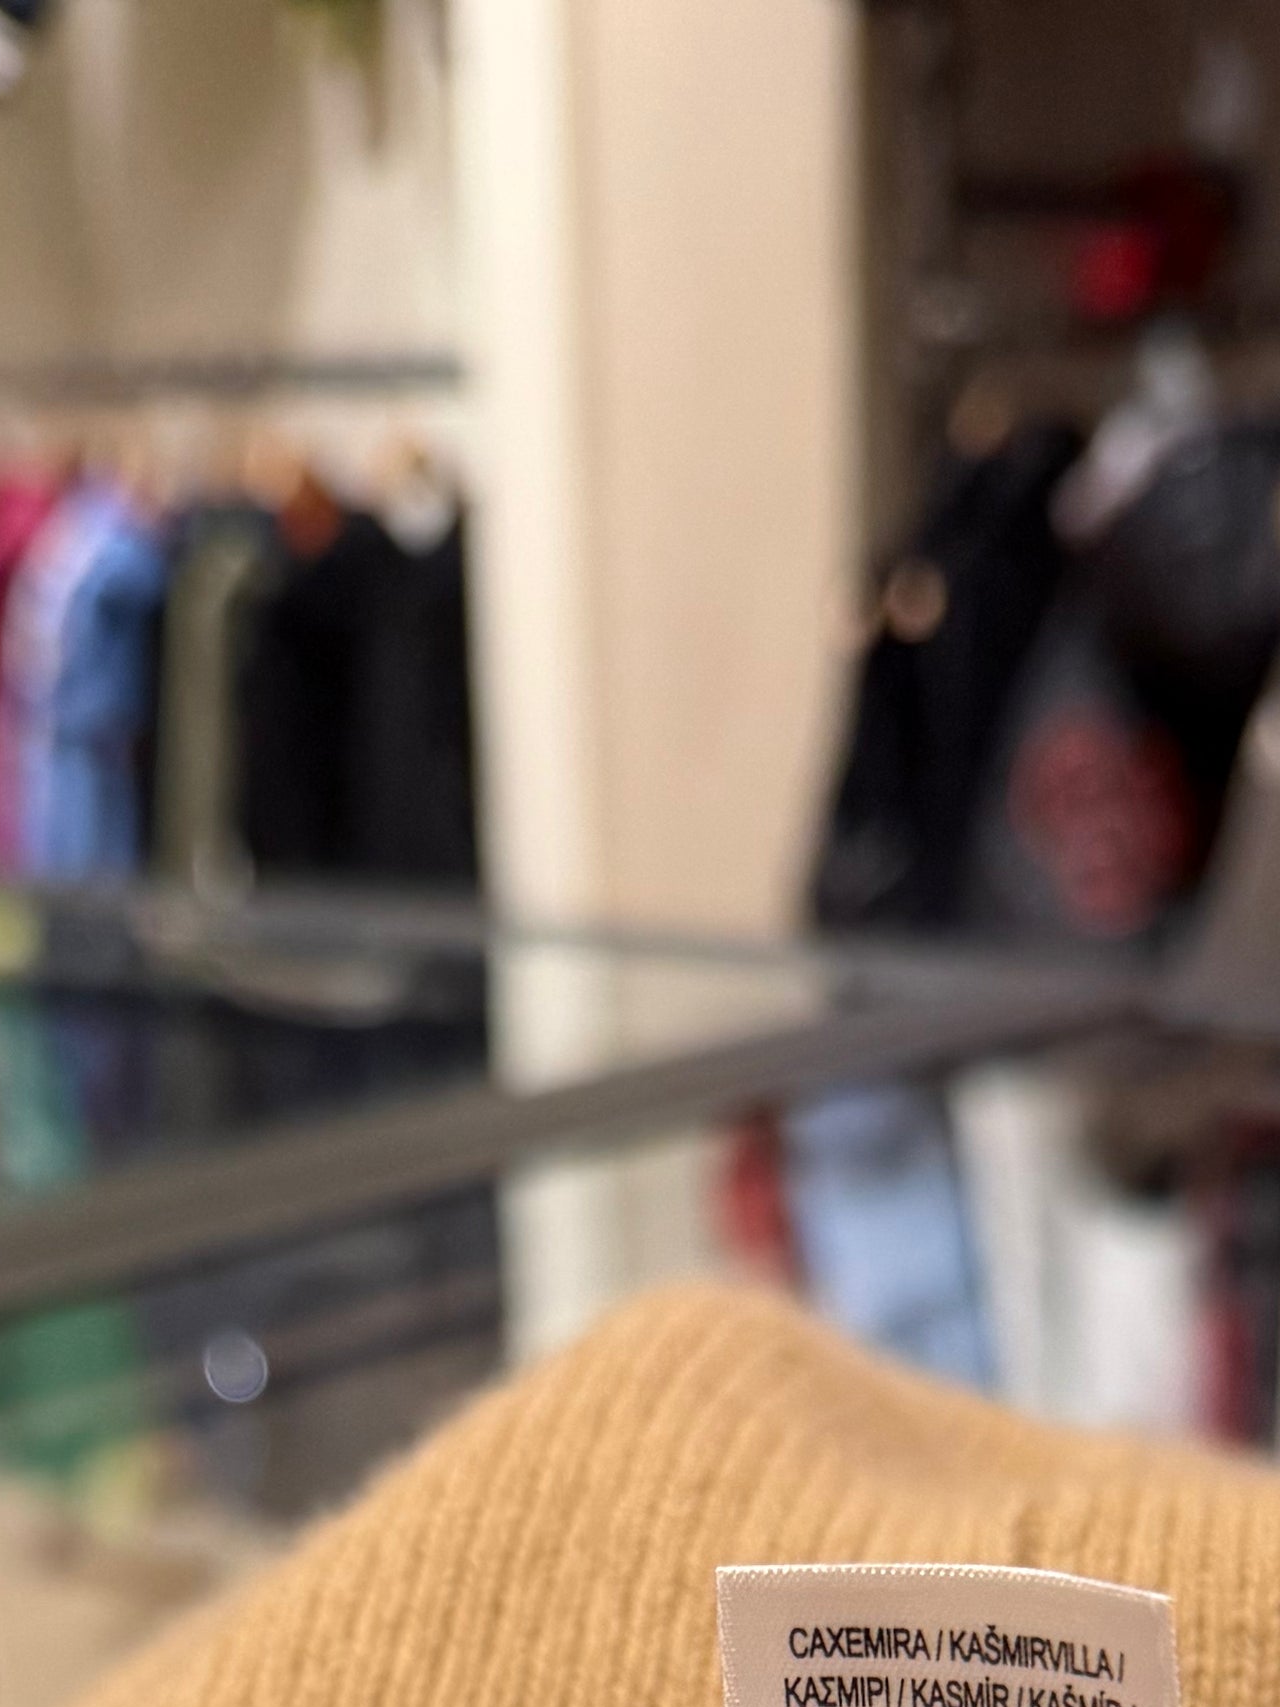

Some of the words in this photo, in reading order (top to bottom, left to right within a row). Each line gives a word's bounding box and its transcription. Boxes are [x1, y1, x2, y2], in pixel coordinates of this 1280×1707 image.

[788, 1627, 931, 1661] CAXEMIRA
[936, 1630, 943, 1661] /
[950, 1624, 1114, 1680] KAŠMIRVILLA
[1117, 1652, 1125, 1683] /
[898, 1678, 905, 1707] /
